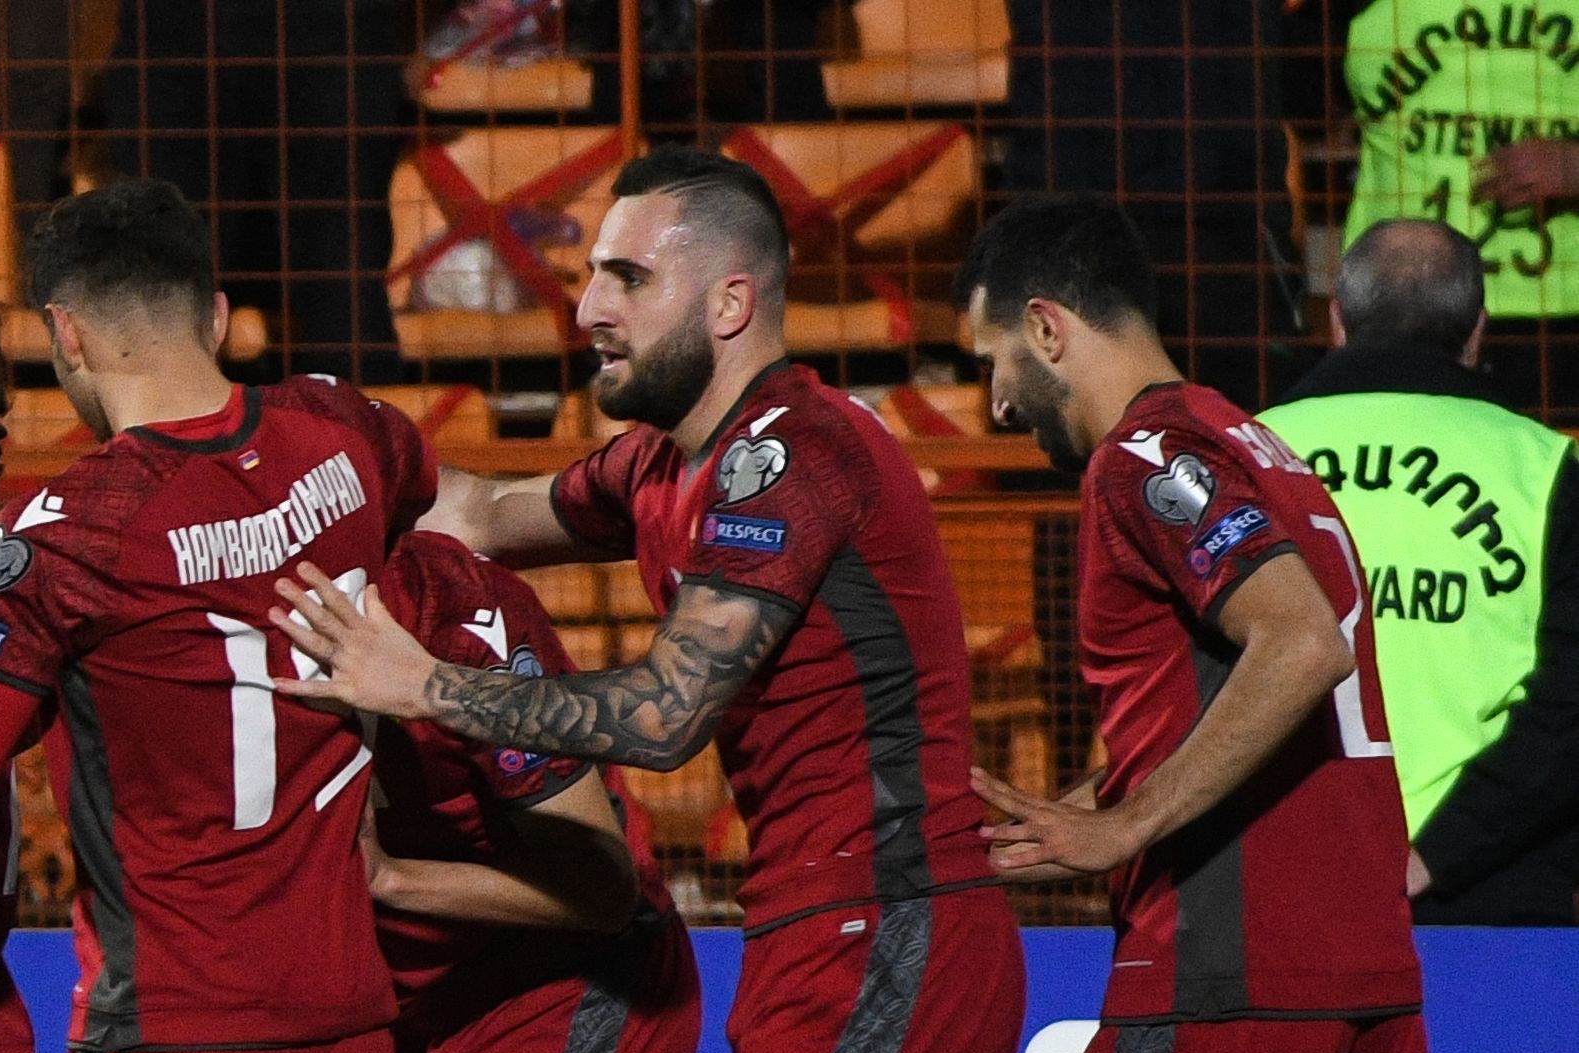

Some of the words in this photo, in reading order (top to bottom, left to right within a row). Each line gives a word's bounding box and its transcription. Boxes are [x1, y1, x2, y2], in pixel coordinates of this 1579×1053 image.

[717, 522, 786, 543] RESPECT
[1204, 509, 1265, 554] RESPECT
[1369, 565, 1468, 623] ARD
